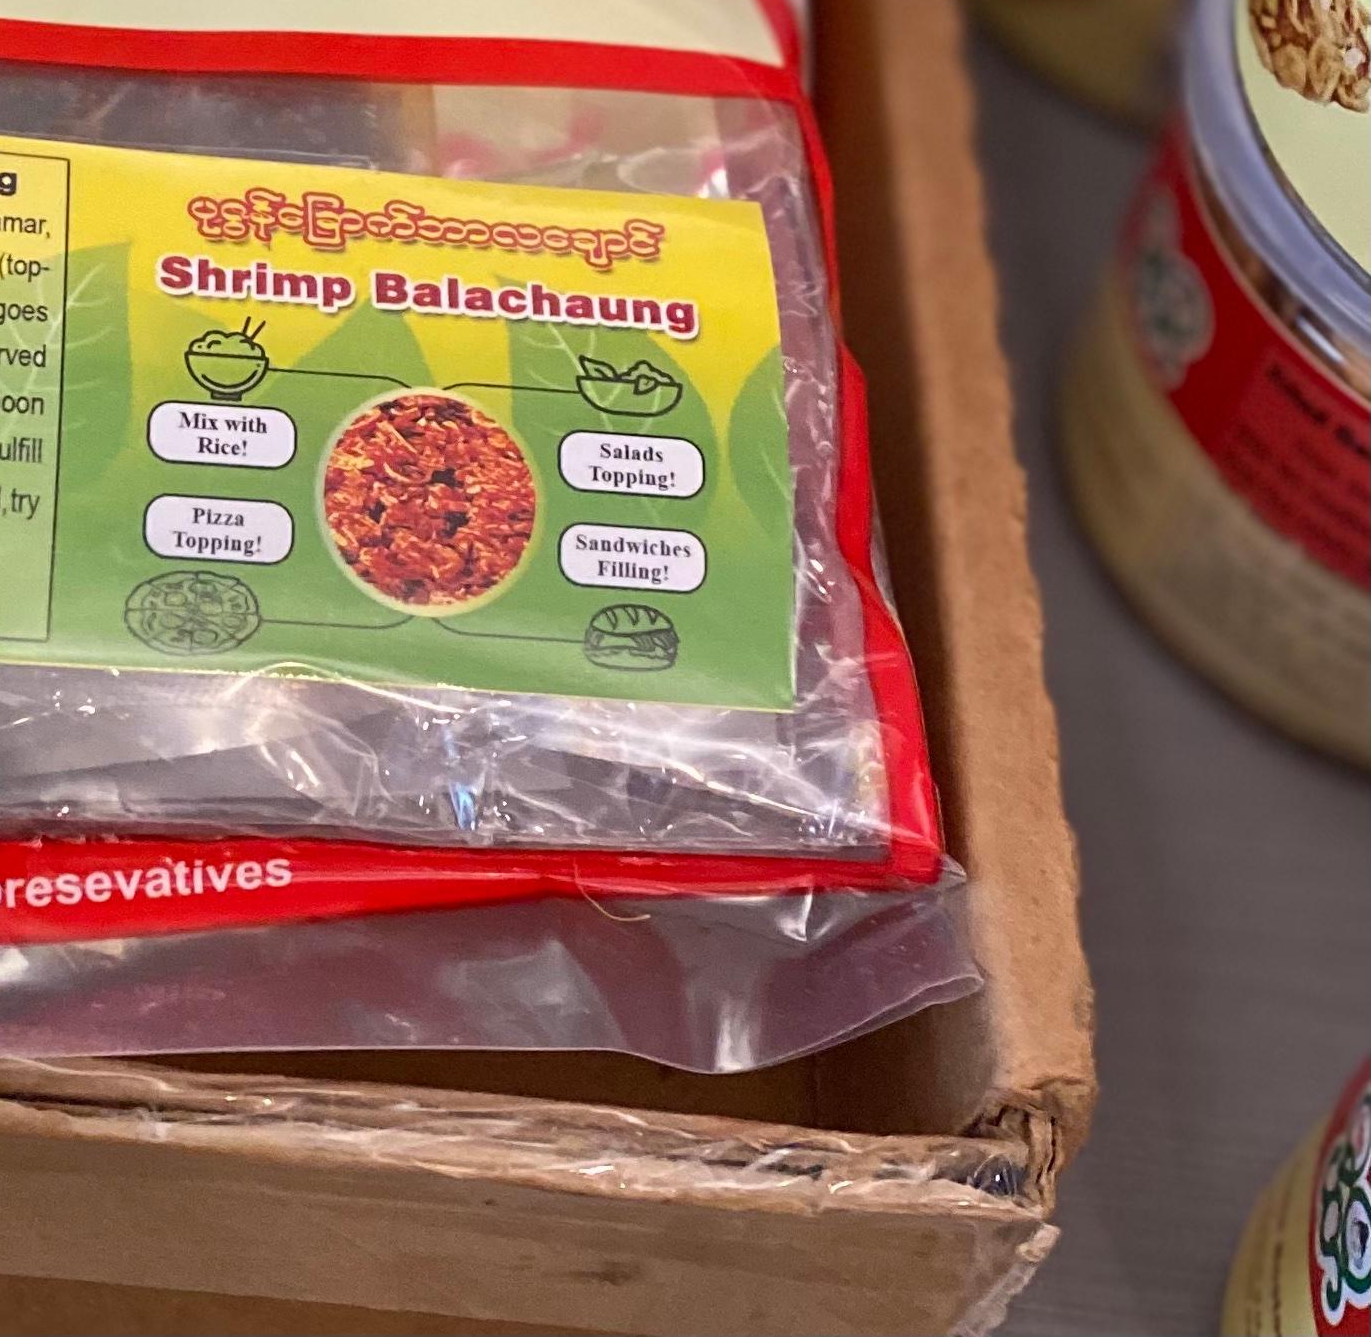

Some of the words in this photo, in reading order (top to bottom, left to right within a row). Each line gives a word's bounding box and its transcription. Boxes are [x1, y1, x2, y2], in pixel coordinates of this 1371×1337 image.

[158, 256, 353, 308] Shrimp
[374, 272, 696, 335] Balachaung
[179, 412, 218, 430] Mix
[225, 417, 268, 434] with
[198, 437, 247, 456] Rice!
[600, 443, 663, 462] Salads
[589, 466, 675, 491] Topping!
[193, 508, 244, 526] Pizza
[173, 531, 262, 556] Topping!
[575, 534, 691, 558] Sandwiches
[598, 561, 669, 584] Filling!
